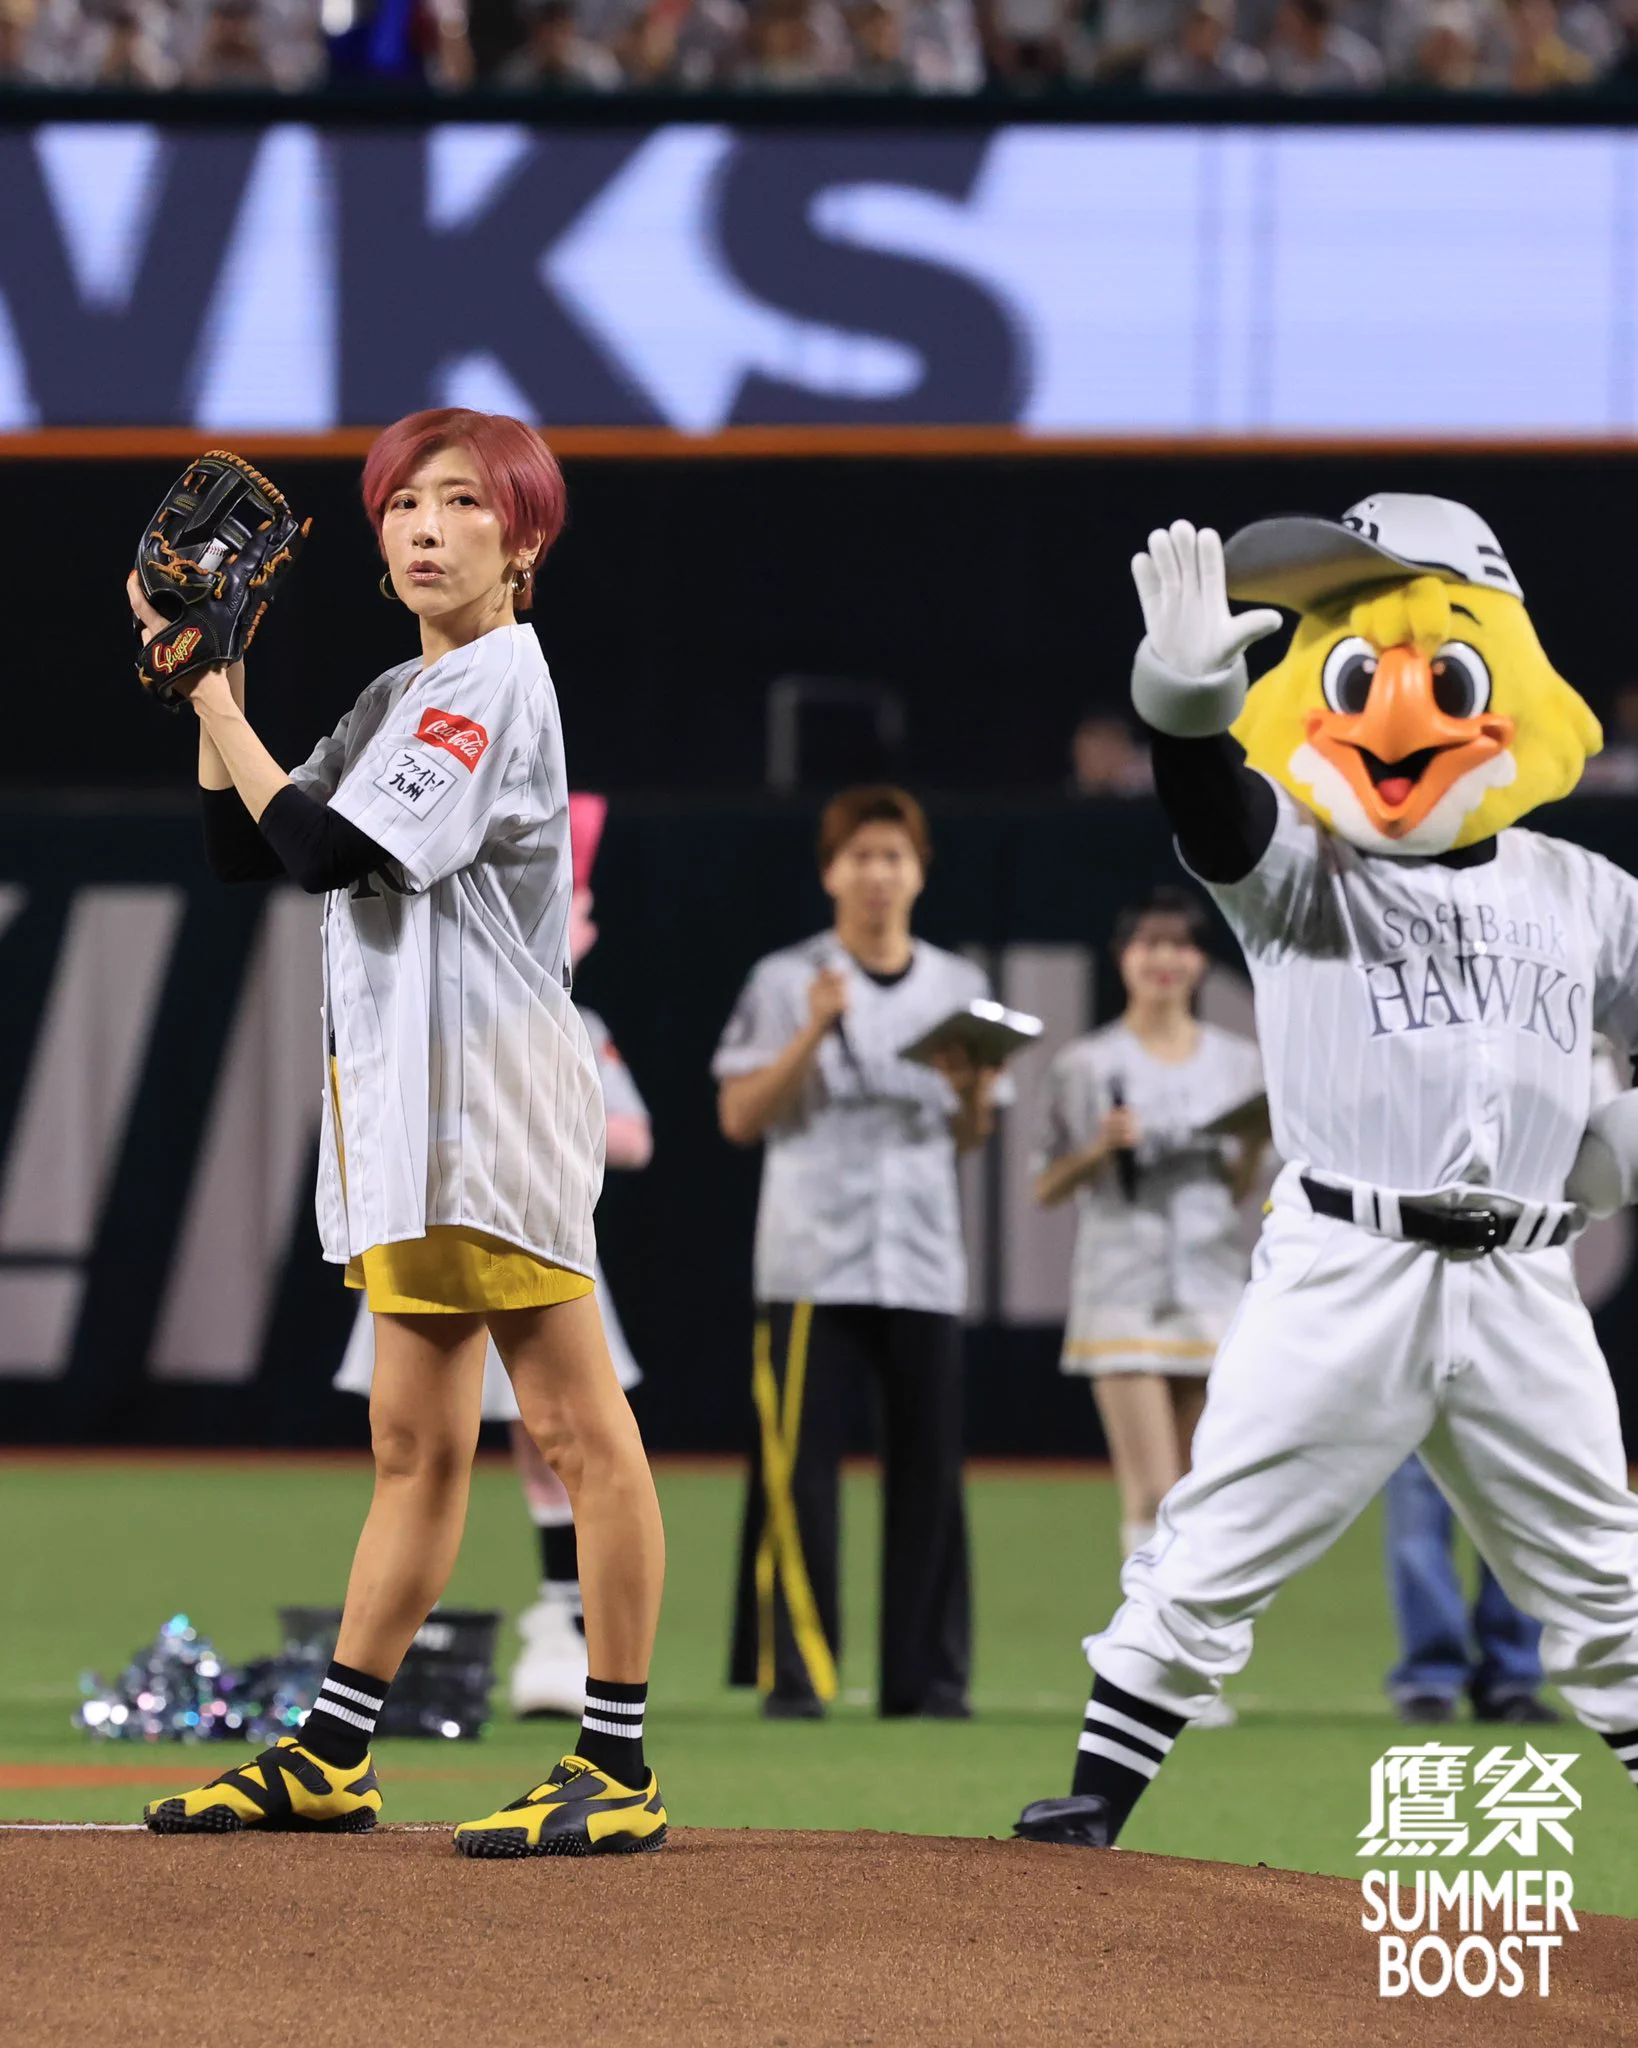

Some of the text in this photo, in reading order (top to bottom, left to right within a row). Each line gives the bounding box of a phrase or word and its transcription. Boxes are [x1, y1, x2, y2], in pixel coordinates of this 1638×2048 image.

[388, 772, 425, 803] 九州
[1383, 903, 1566, 961] SoftBank
[1365, 954, 1587, 1054] HAWKS
